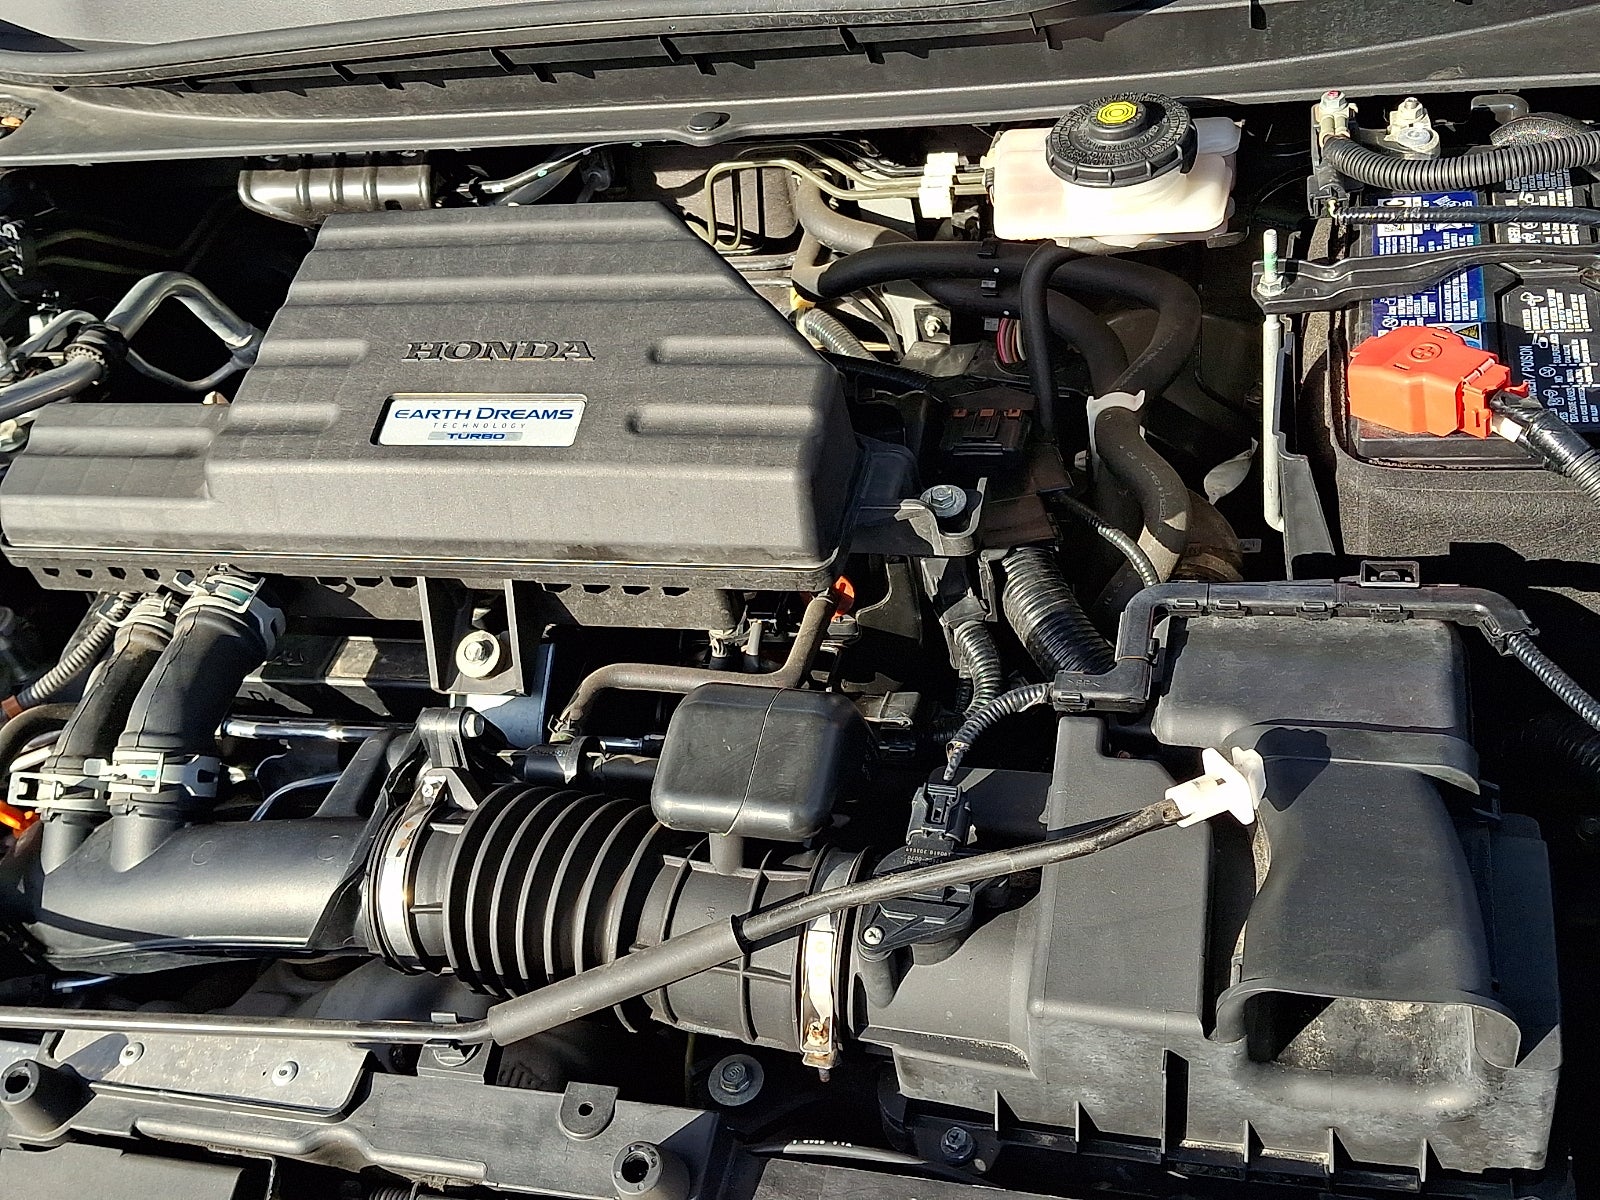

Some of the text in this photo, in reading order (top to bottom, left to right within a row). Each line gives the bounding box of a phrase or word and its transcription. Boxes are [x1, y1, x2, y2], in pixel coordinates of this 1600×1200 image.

[401, 340, 597, 361] HONDA
[1519, 345, 1535, 371] POISON
[394, 407, 575, 420] EARTH DREAMS
[447, 432, 506, 440] TURBO
